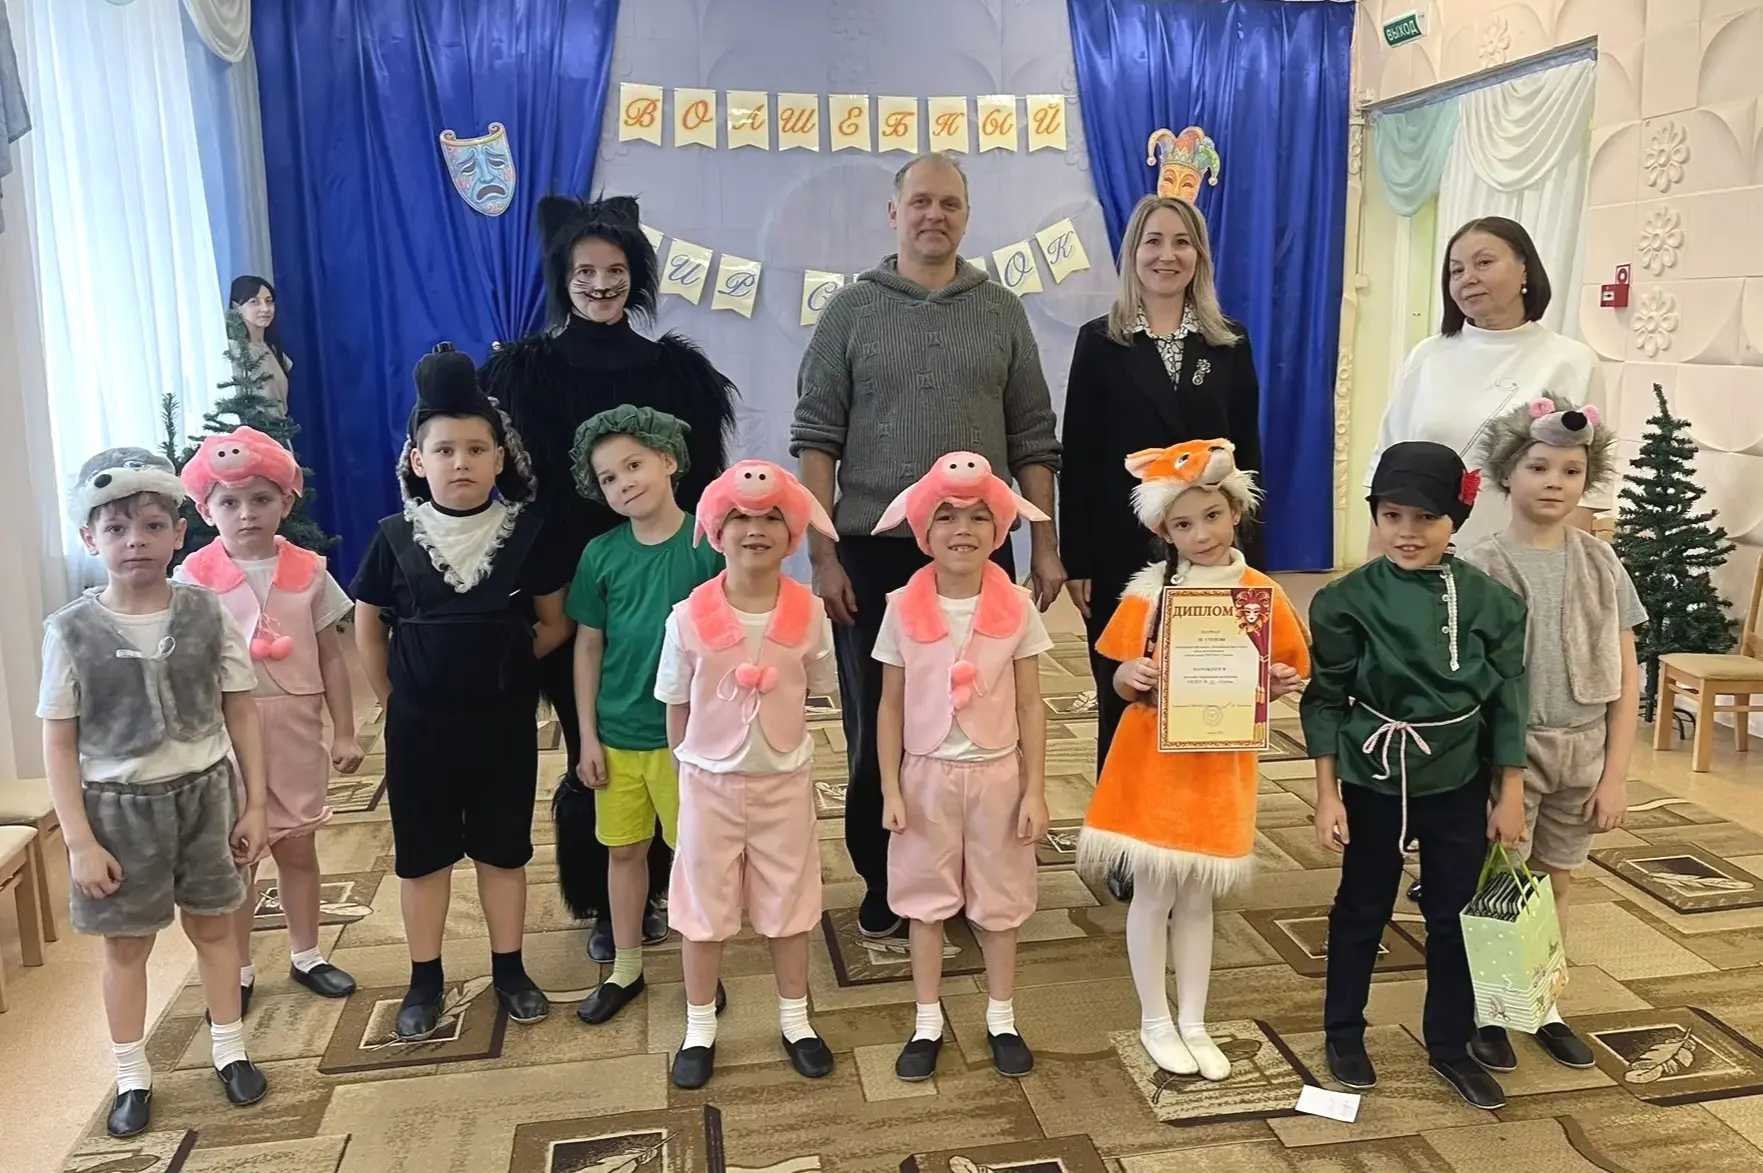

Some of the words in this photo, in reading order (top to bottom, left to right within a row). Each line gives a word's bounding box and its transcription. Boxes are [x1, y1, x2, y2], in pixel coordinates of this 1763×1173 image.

[1386, 20, 1419, 41] ВЫХОД
[624, 98, 1061, 137] ВОЛШЕБНЫЙ
[656, 245, 757, 297] ИР
[1173, 605, 1234, 618] ДИПЛОМ
